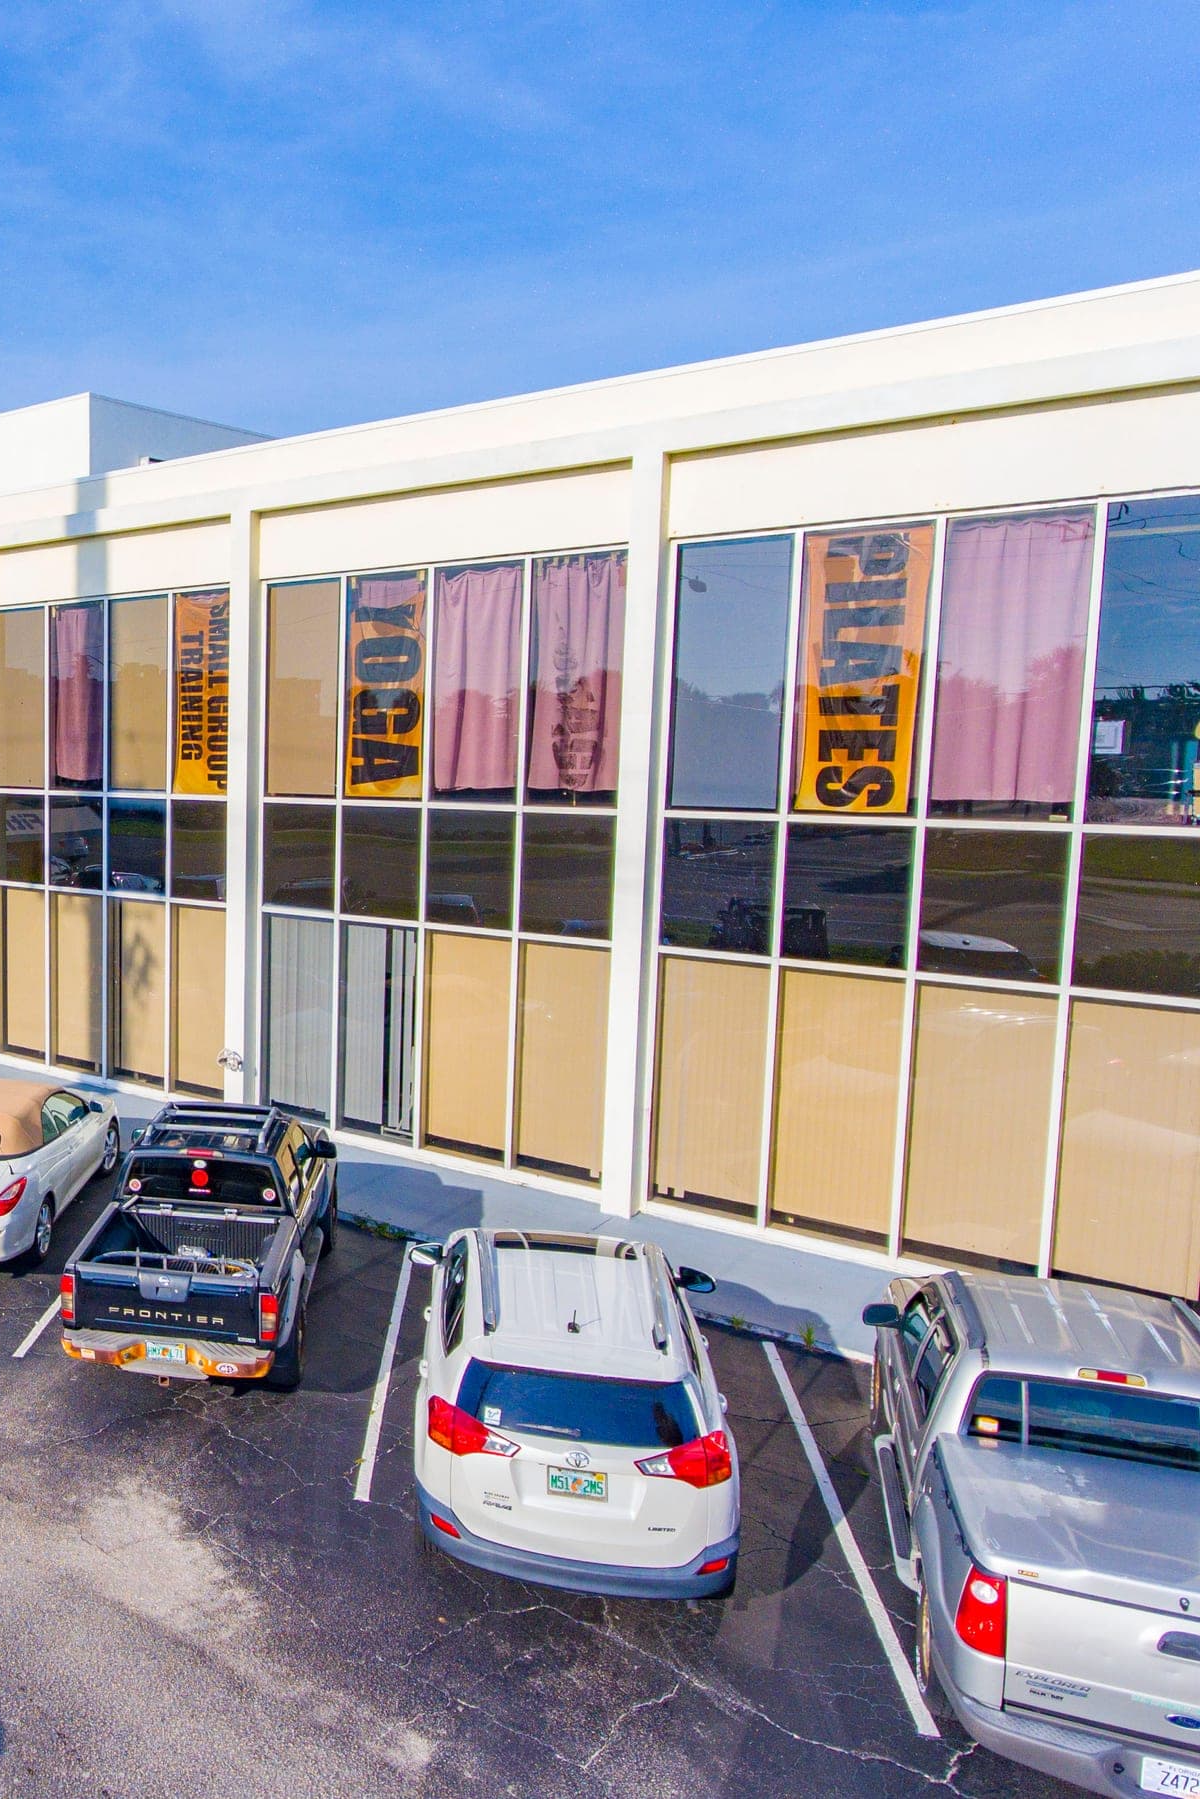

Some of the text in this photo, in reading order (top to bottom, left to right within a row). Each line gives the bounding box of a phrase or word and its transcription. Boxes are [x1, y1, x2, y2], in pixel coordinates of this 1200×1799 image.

[181, 630, 204, 761] TRAINING
[207, 602, 229, 790] SMALL GROUP
[351, 604, 422, 786] YOGA
[816, 532, 910, 808] PILATES
[108, 1306, 224, 1325] FRONTIER
